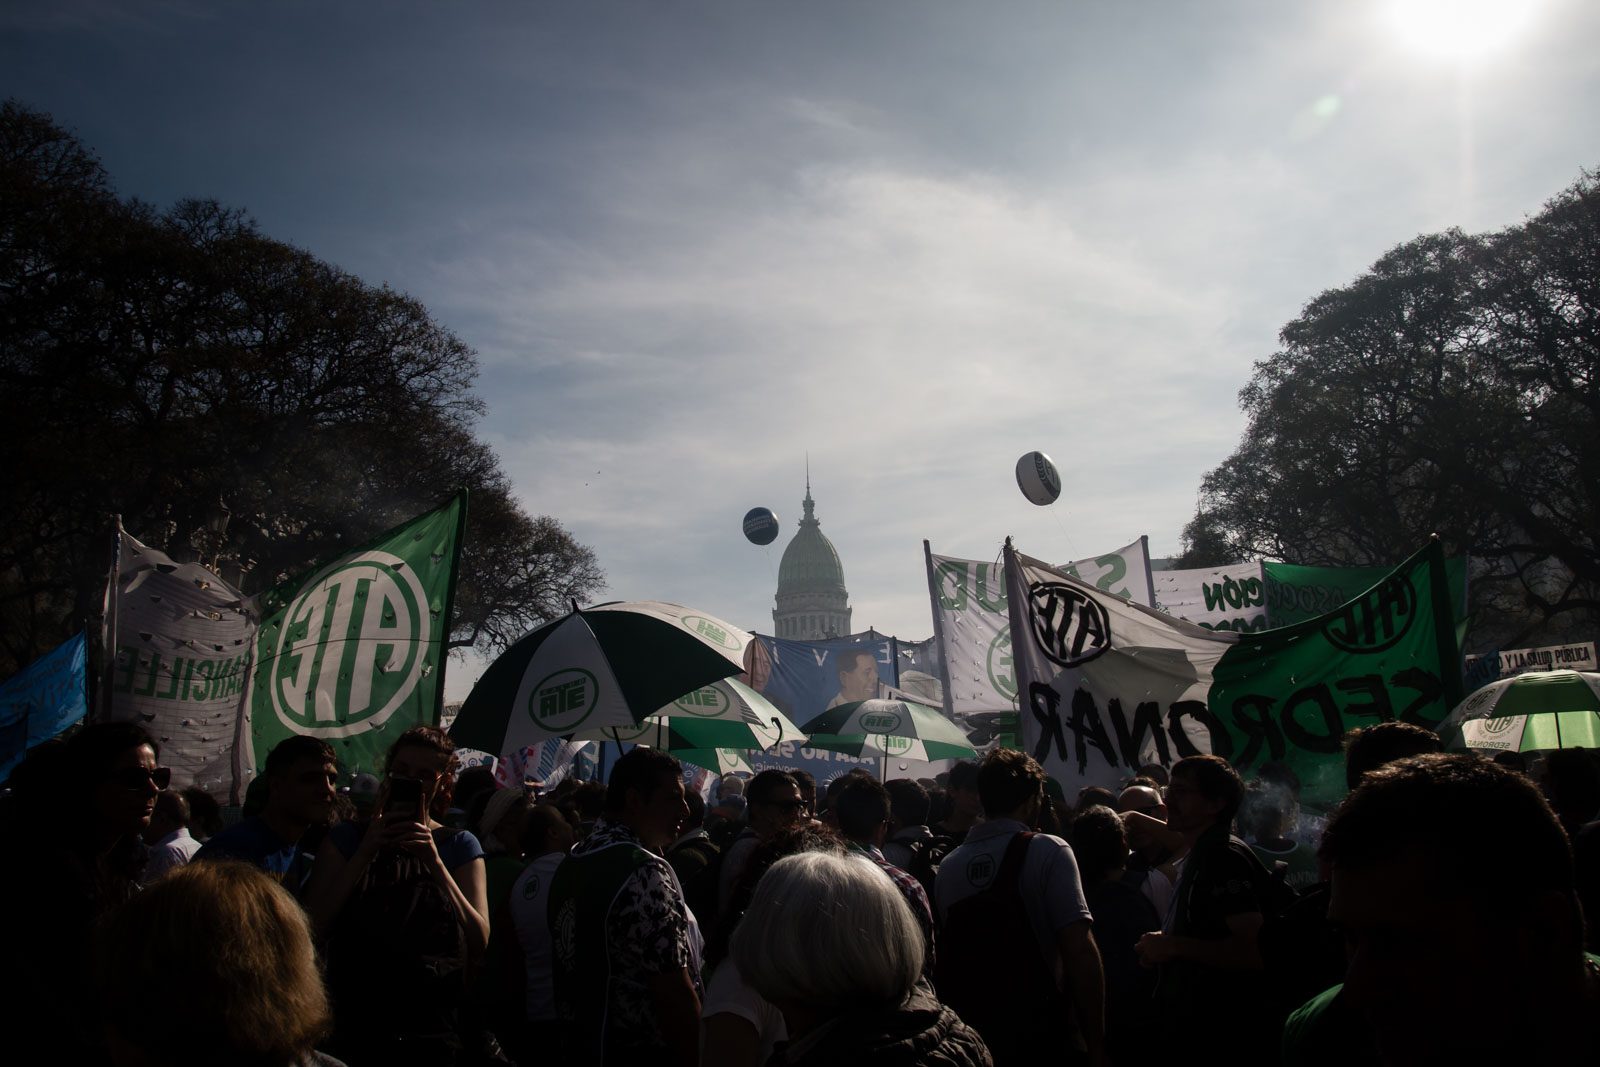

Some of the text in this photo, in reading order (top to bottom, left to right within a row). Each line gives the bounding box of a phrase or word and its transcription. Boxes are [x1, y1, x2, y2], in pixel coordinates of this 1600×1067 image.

[1505, 654, 1513, 667] Y
[1514, 653, 1525, 667] LA
[1527, 650, 1553, 666] SALUD
[1555, 646, 1591, 663] PÚBLICA
[540, 684, 585, 718] ATE
[864, 717, 894, 727] ATE
[970, 863, 991, 880] ATE
